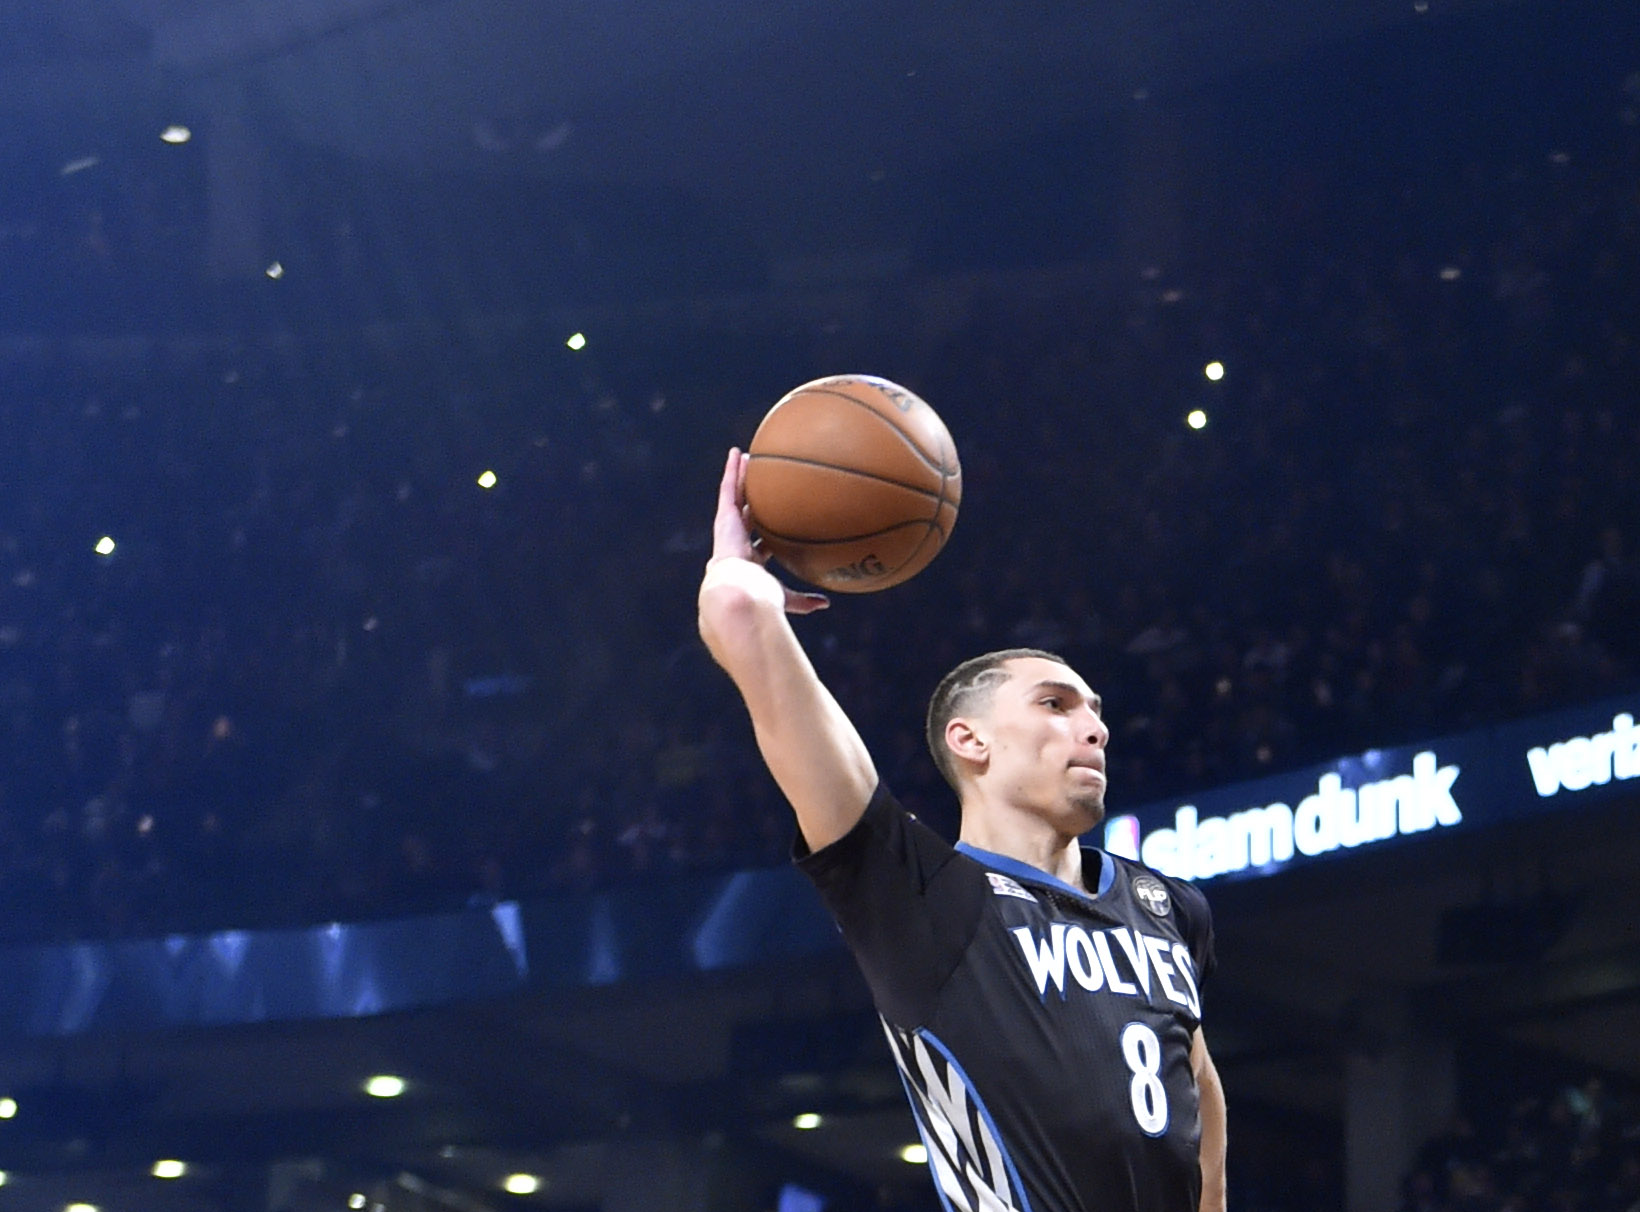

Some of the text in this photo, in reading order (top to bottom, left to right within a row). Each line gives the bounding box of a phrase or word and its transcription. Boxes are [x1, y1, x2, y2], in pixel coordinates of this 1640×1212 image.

[1142, 751, 1462, 881] slam dunk
[1008, 921, 1202, 1019] WOLVES
[1120, 1021, 1170, 1138] 8
